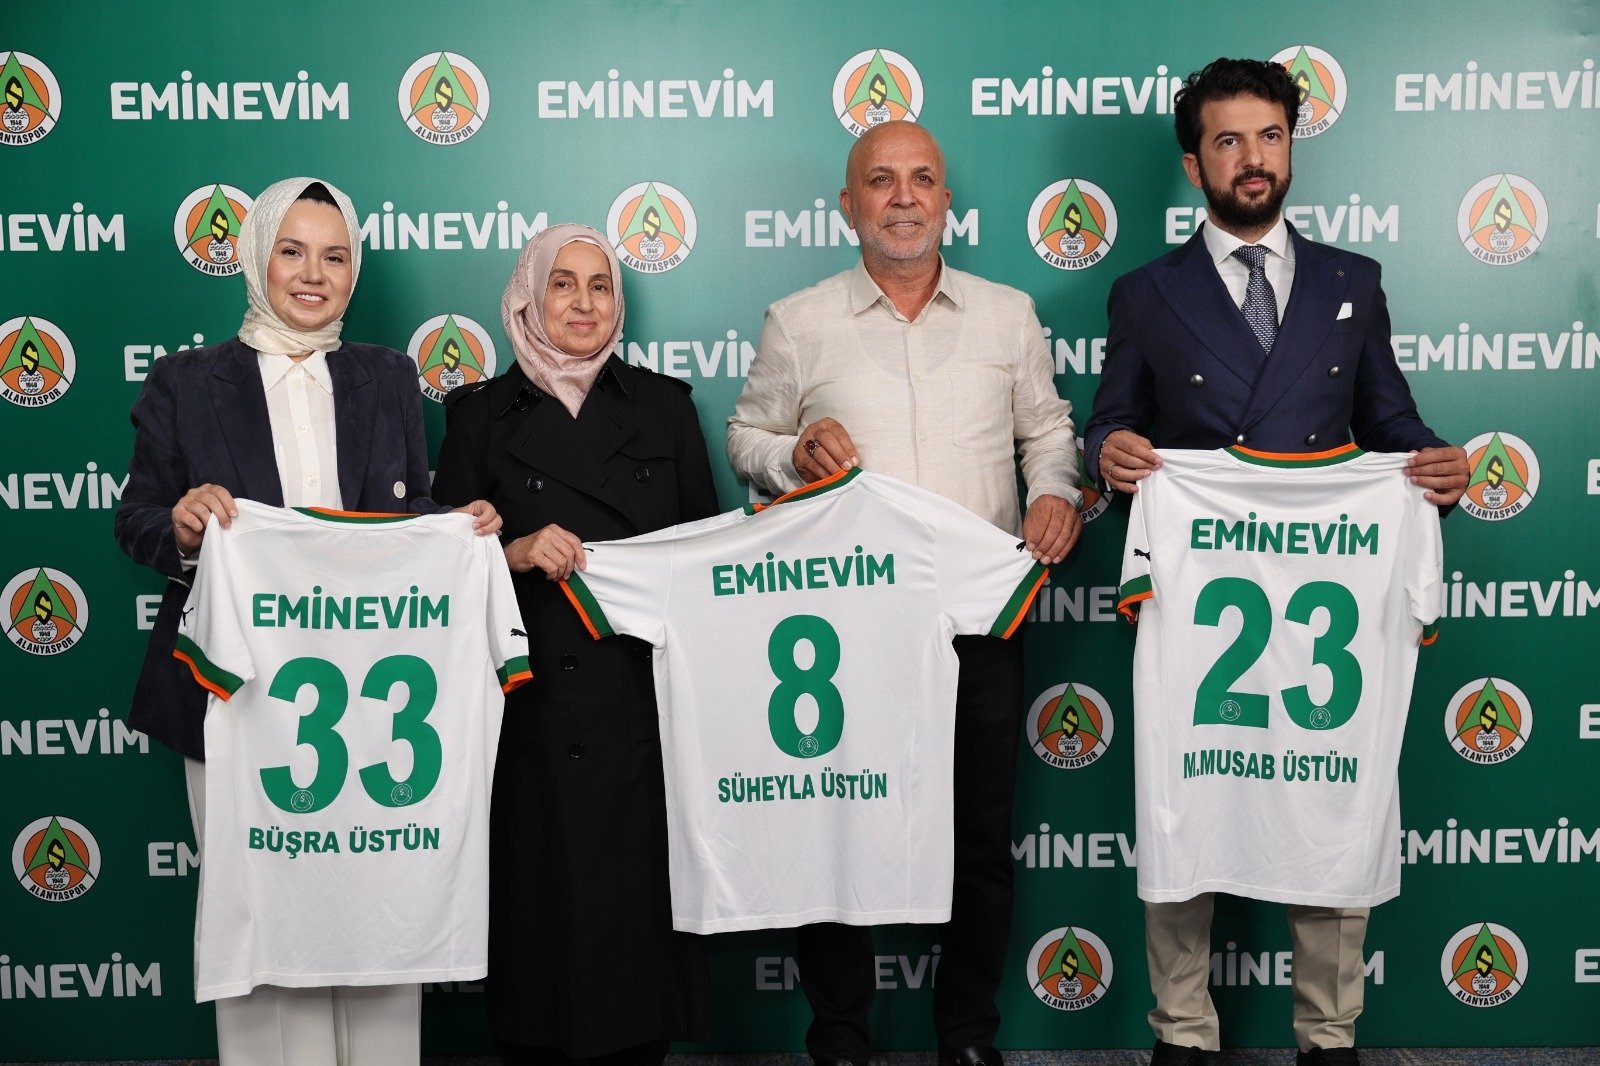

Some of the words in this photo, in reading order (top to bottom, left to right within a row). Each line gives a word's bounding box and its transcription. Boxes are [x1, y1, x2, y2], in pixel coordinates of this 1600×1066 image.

[110, 70, 350, 120] EMİNEVİM
[538, 68, 774, 118] EMİNEVİM
[1395, 58, 1600, 111] EMİNEVİ
[415, 126, 475, 144] ALANYASPOR
[623, 254, 682, 272] ALANYASPOR
[1043, 250, 1102, 269] ALANYASPOR
[1472, 246, 1532, 265] ALANYASPOR
[2, 388, 62, 406] ALANYASPOR
[1465, 502, 1523, 520] ALANYASPOR
[1190, 511, 1379, 556] EMİNEVİM
[712, 544, 896, 596] EMİNEVİM
[252, 585, 450, 629] EMİNEVİM
[15, 637, 75, 655] ALANYASPOR
[1192, 577, 1363, 730] 23
[768, 614, 845, 759] 8
[259, 655, 443, 814] 33
[1041, 750, 1099, 768] ALANYASPOR
[1183, 749, 1275, 780] M.MUSAB
[1283, 750, 1358, 783] ÜSTÜN
[1459, 745, 1517, 763] ALANYASPOR
[718, 772, 815, 803] SÜHEYLA
[821, 767, 887, 800] ÜSTÜN
[249, 825, 340, 860] BÜŞRA
[349, 823, 440, 854] ÜSTÜN
[29, 883, 87, 901] ALANYASPOR
[1041, 993, 1099, 1010] ALANYASPOR
[1455, 989, 1513, 1007] ALANYASPOR
